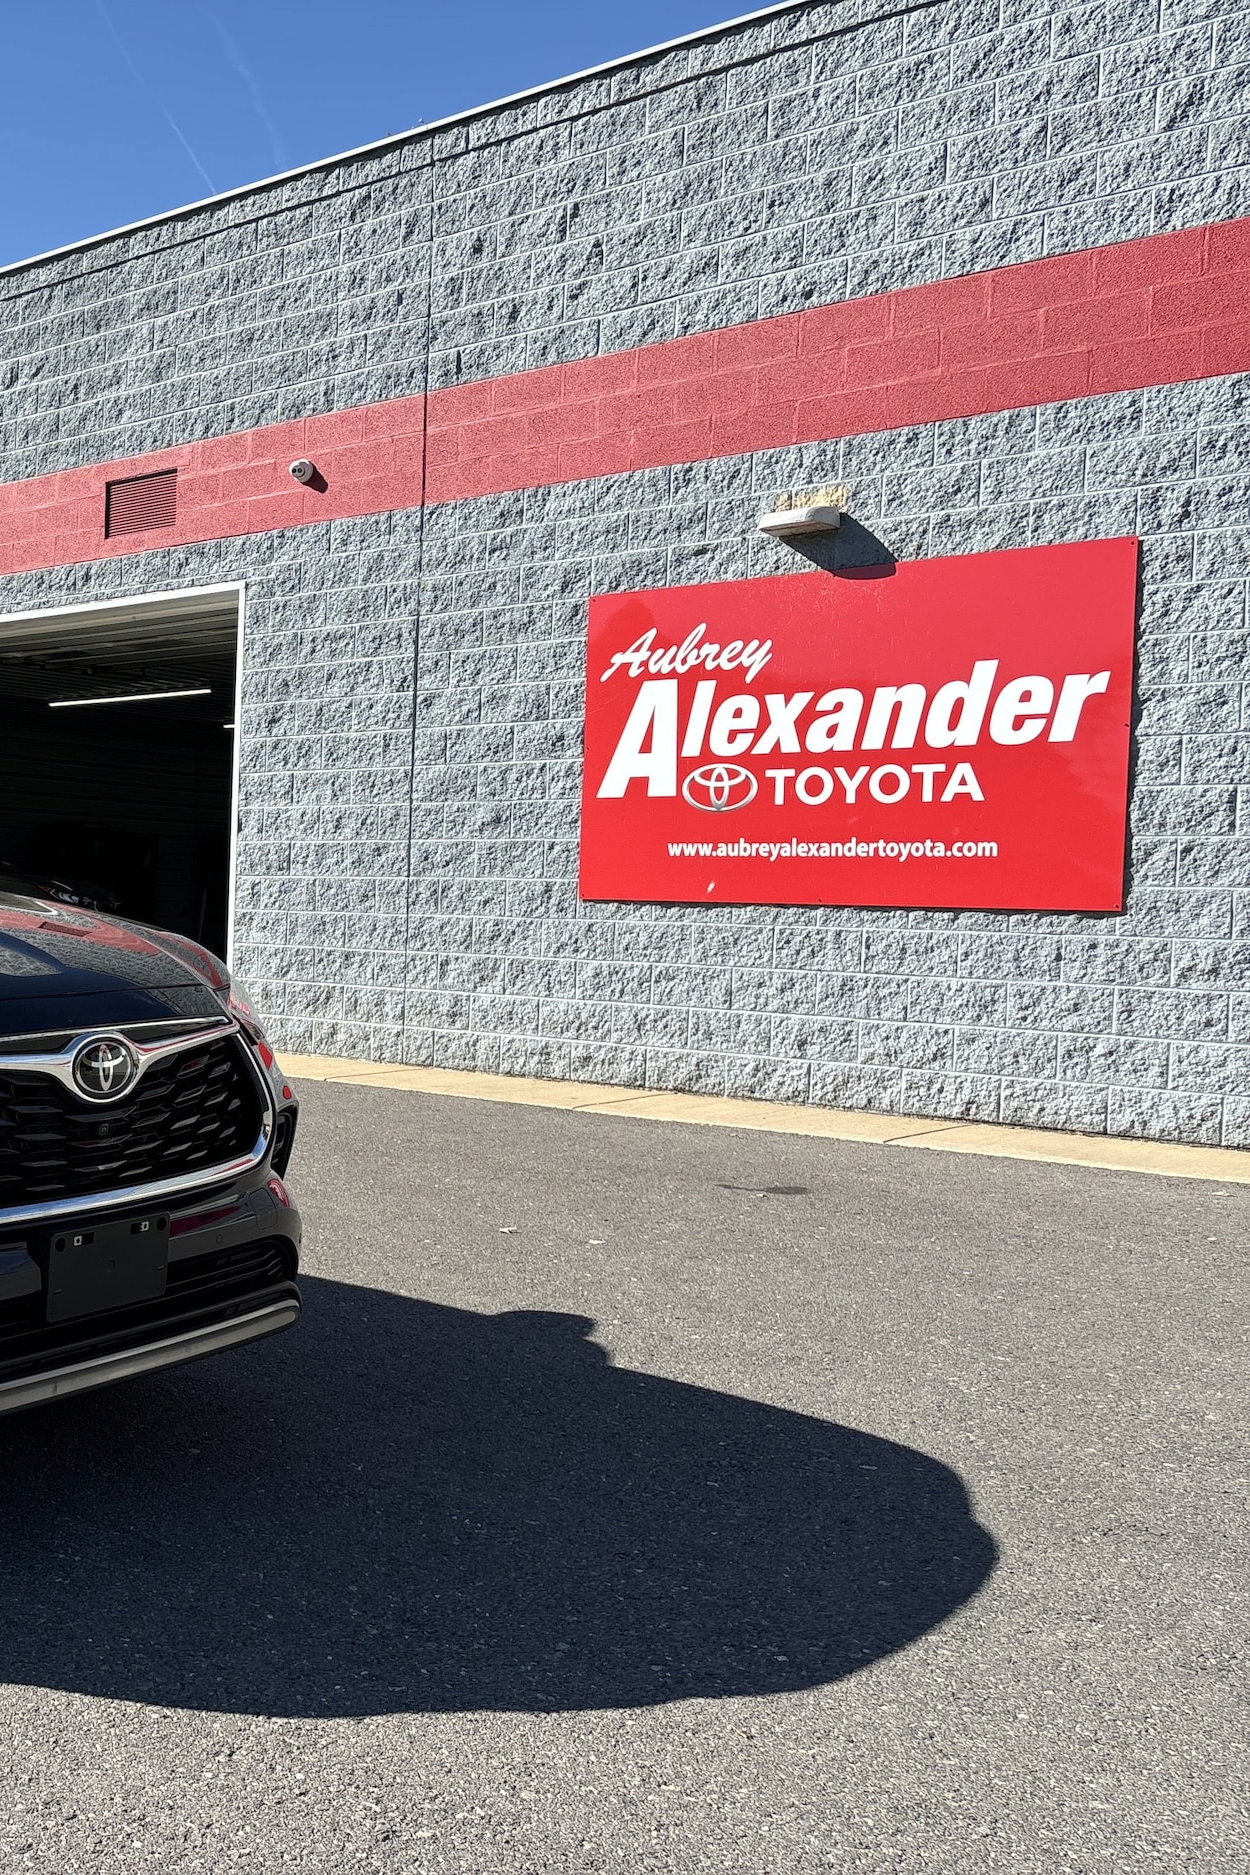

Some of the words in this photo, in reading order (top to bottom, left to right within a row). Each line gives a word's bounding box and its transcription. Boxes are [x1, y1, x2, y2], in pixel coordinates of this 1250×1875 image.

[600, 622, 773, 684] Aubrey
[595, 659, 1111, 799] Alexander
[764, 762, 985, 806] TOYOTA
[667, 836, 998, 863] www.aubreyalexandertoyota.com
